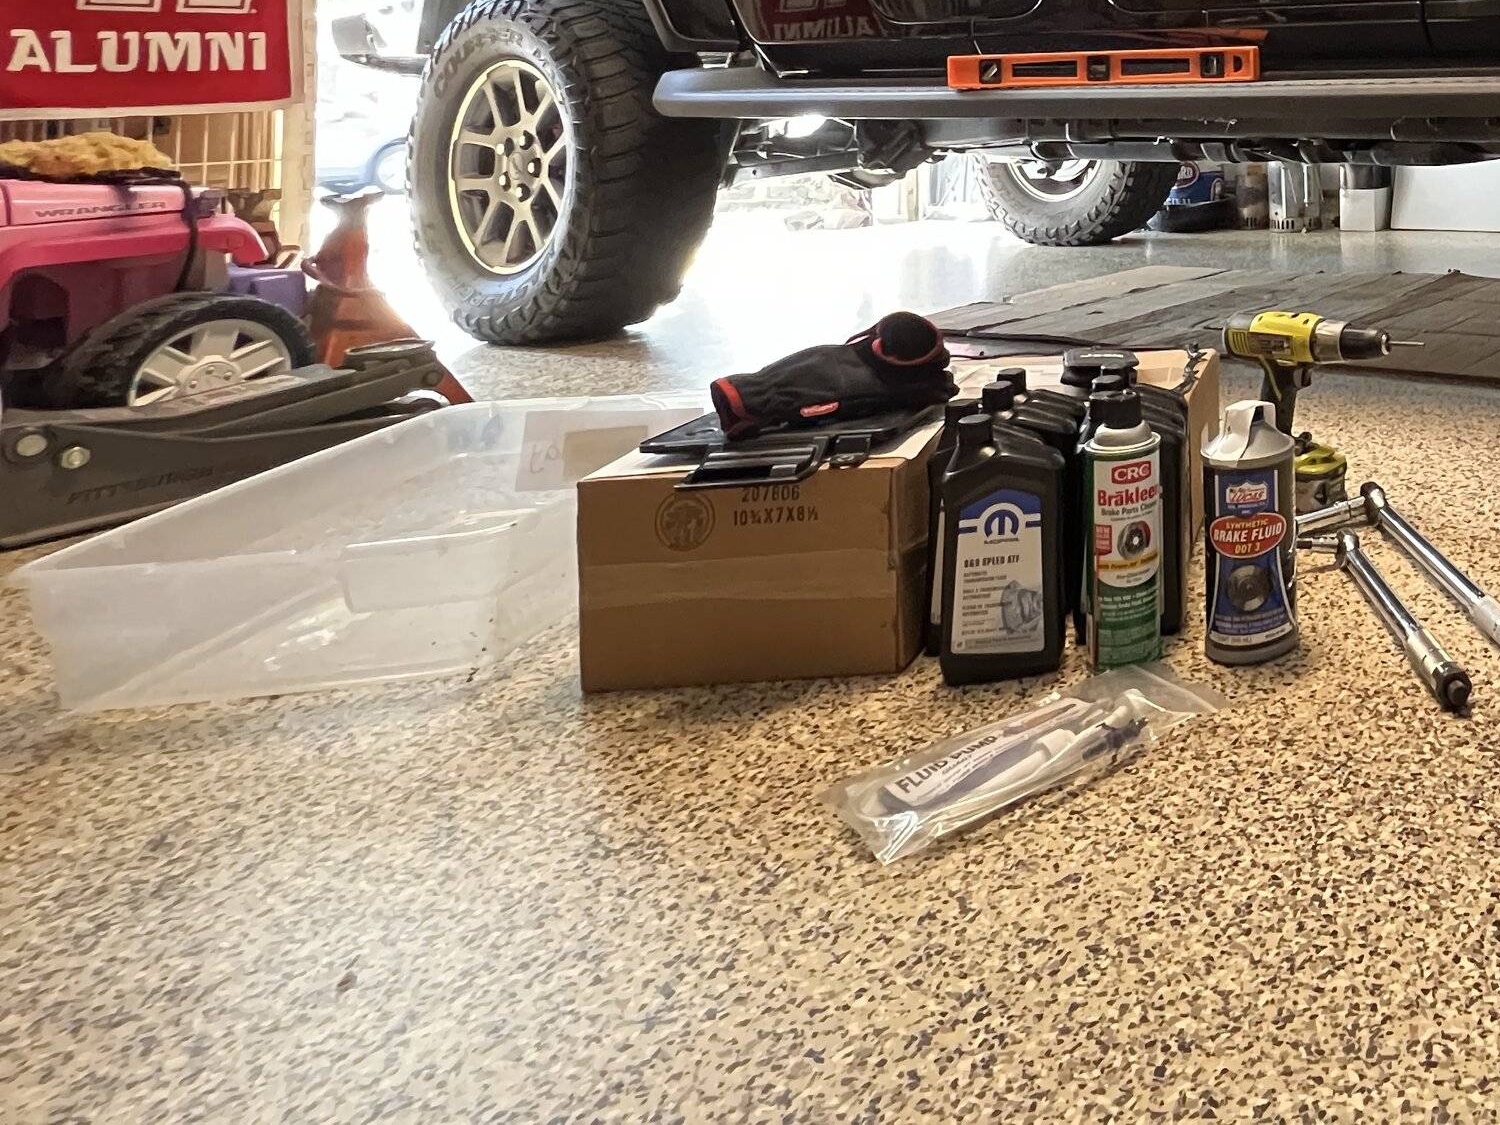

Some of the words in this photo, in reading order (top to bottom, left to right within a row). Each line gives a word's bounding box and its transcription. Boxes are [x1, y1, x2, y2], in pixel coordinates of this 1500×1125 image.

[6, 29, 267, 73] ALUMNI
[35, 201, 166, 218] WRANGLER
[1113, 463, 1150, 481] CRC
[1213, 529, 1248, 543] BRAKE
[1251, 522, 1283, 541] FLUID
[1226, 519, 1269, 530] SYNTHETIC
[1234, 542, 1252, 554] DOT
[1254, 542, 1261, 552] 3
[982, 556, 1005, 566] SPEED
[894, 759, 948, 794] FLUID
